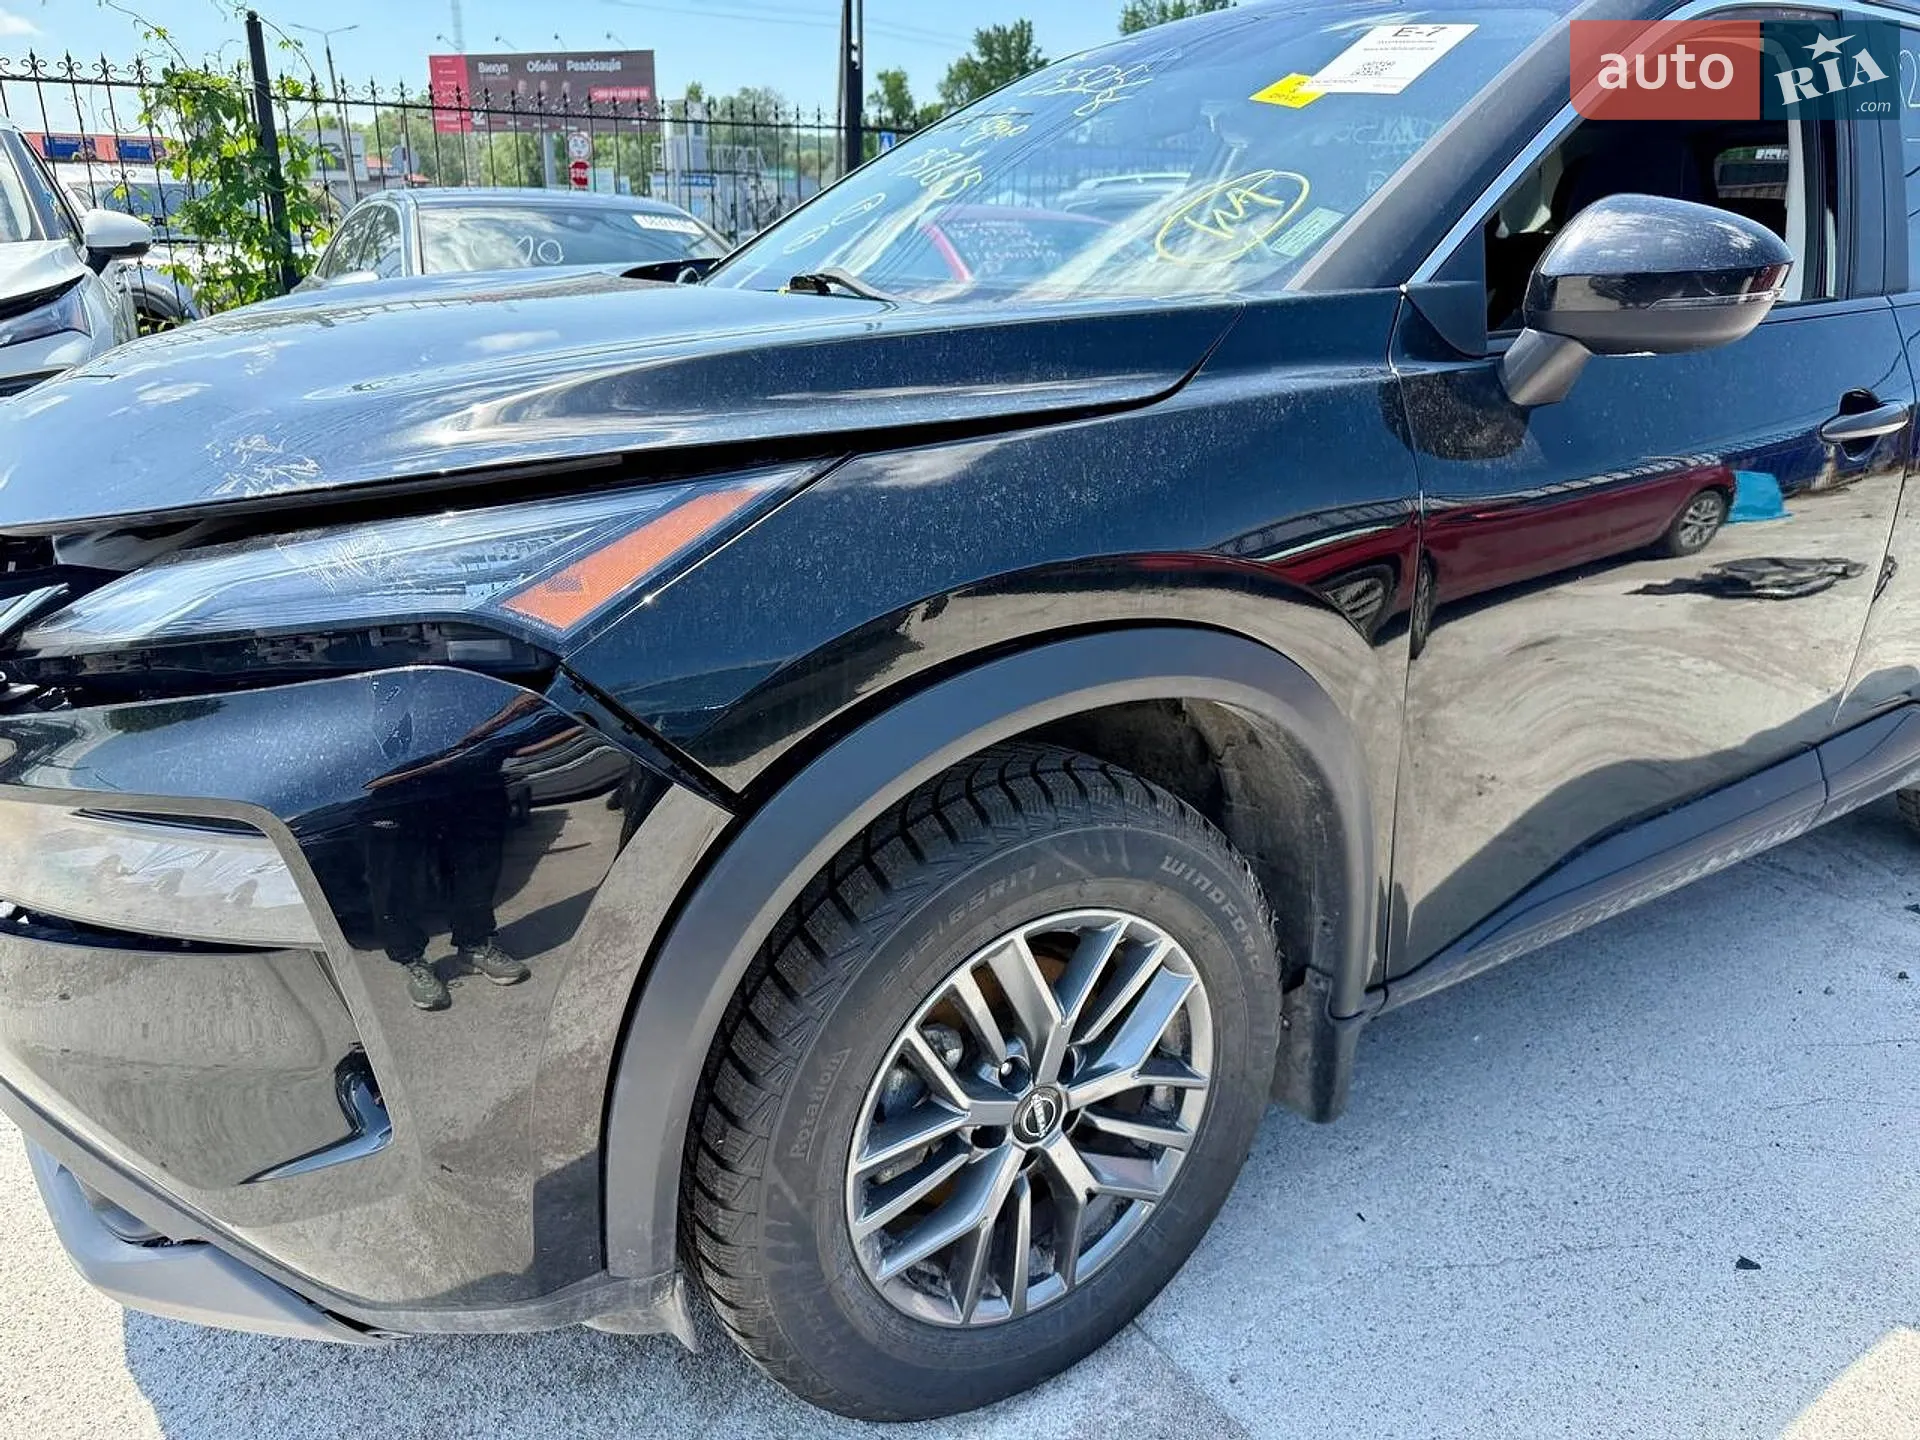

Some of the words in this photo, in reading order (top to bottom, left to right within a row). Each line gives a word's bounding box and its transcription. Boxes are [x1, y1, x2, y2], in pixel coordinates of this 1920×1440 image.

[1392, 25, 1449, 38] E-7
[478, 61, 509, 76] Викуп
[526, 59, 559, 73] Обмін
[566, 57, 622, 73] Реалізація
[789, 1056, 841, 1158] Rotation
